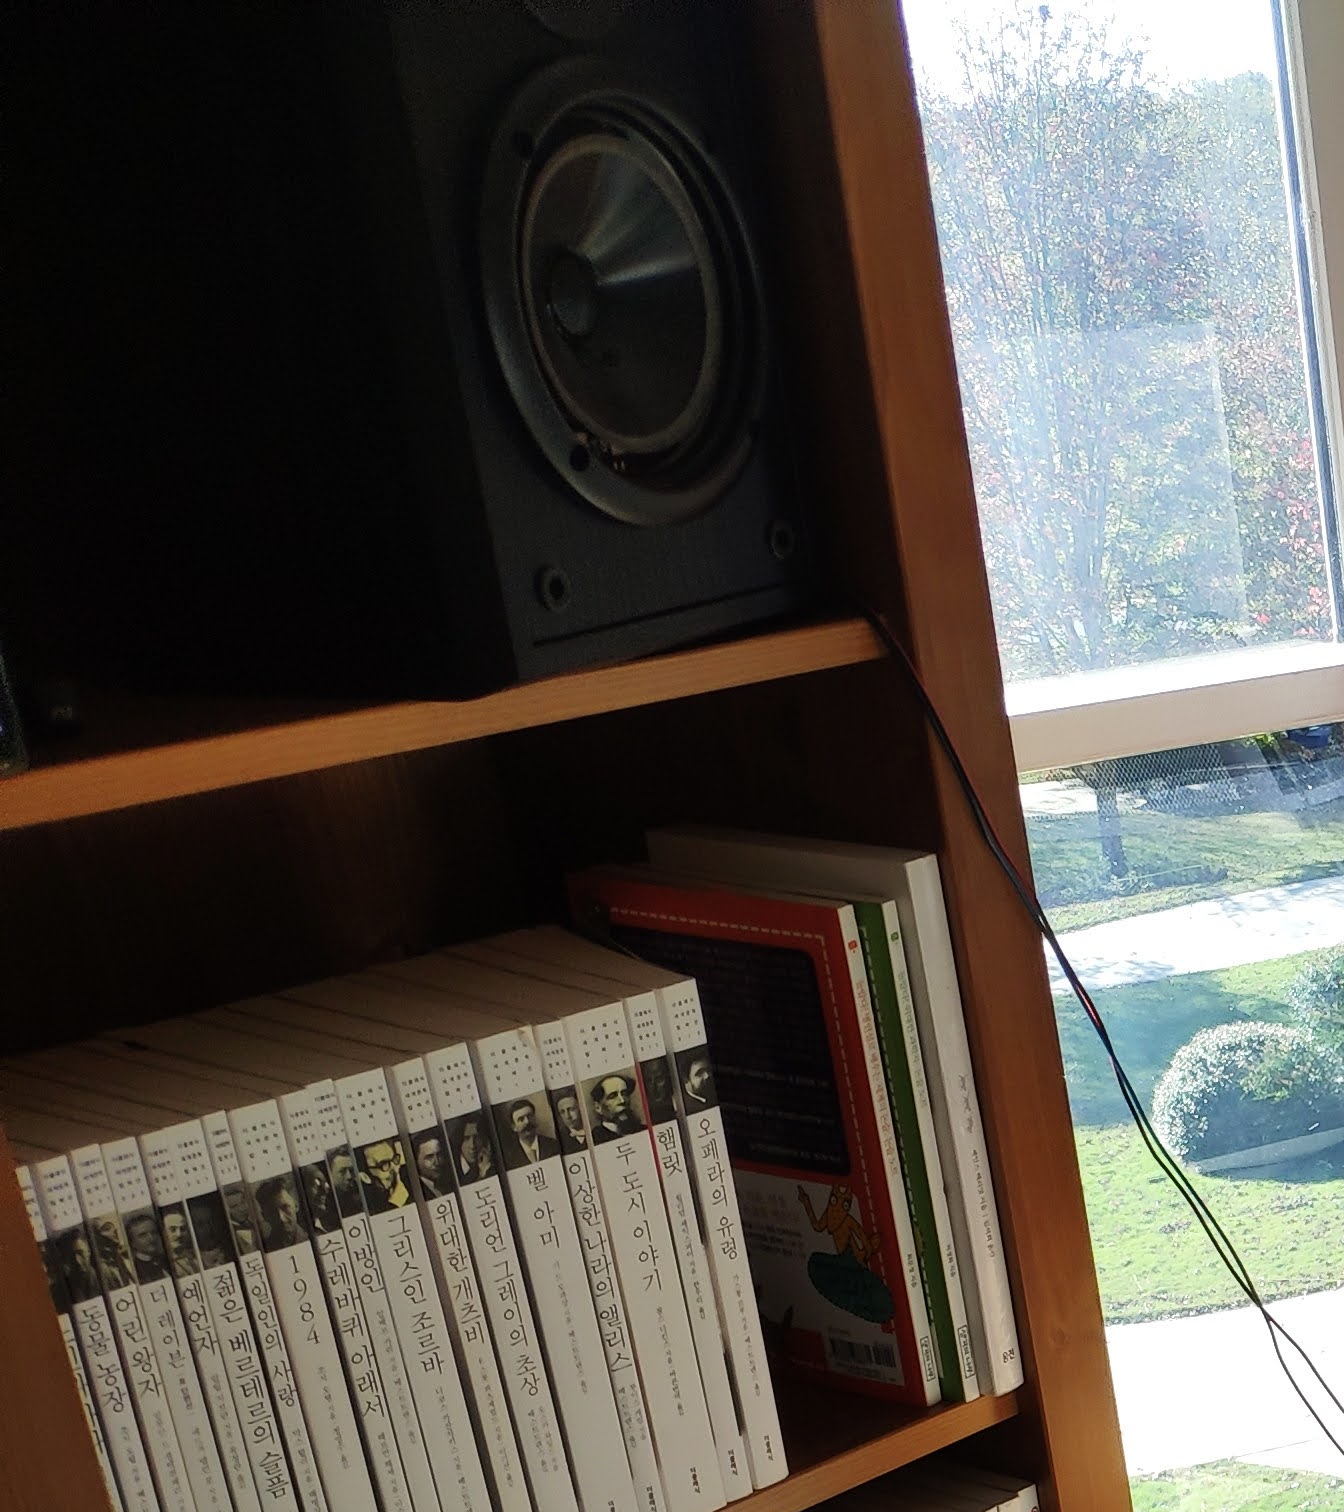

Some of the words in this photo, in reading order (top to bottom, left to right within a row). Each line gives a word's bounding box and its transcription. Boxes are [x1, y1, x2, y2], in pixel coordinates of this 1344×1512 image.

[527, 1167, 549, 1191] 벨
[616, 1142, 636, 1165] 두
[657, 1126, 682, 1177] 햄릿
[698, 1118, 728, 1207] 오페라의
[716, 1216, 737, 1259] 유령
[533, 1201, 560, 1248] 아미
[622, 1171, 646, 1214] 도시
[349, 1219, 385, 1293] 이방인
[435, 1200, 468, 1273] 위대한
[452, 1277, 484, 1344] 개츠비
[475, 1187, 506, 1252] 도리언
[493, 1260, 528, 1347] 그레이의
[516, 1354, 540, 1396] 초상
[633, 1220, 662, 1291] 이야기
[151, 1285, 168, 1302] 더
[183, 1279, 218, 1355] 예언자
[320, 1239, 364, 1337] 수레바퀴
[351, 1345, 385, 1417] 아래서
[388, 1216, 426, 1304] 그리스인
[412, 1311, 445, 1375] 조르바
[80, 1305, 107, 1356] 동물
[97, 1364, 127, 1412] 농장
[116, 1290, 146, 1343] 어린
[133, 1347, 162, 1397] 왕자
[158, 1309, 185, 1369] 레이븐
[245, 1259, 282, 1351] 독일인의
[273, 1360, 297, 1408] 사랑
[600, 1303, 633, 1372] 앨리스
[213, 1270, 243, 1323] 젊은
[229, 1329, 276, 1444] 베르테르의
[260, 1452, 290, 1500] 슬픔
